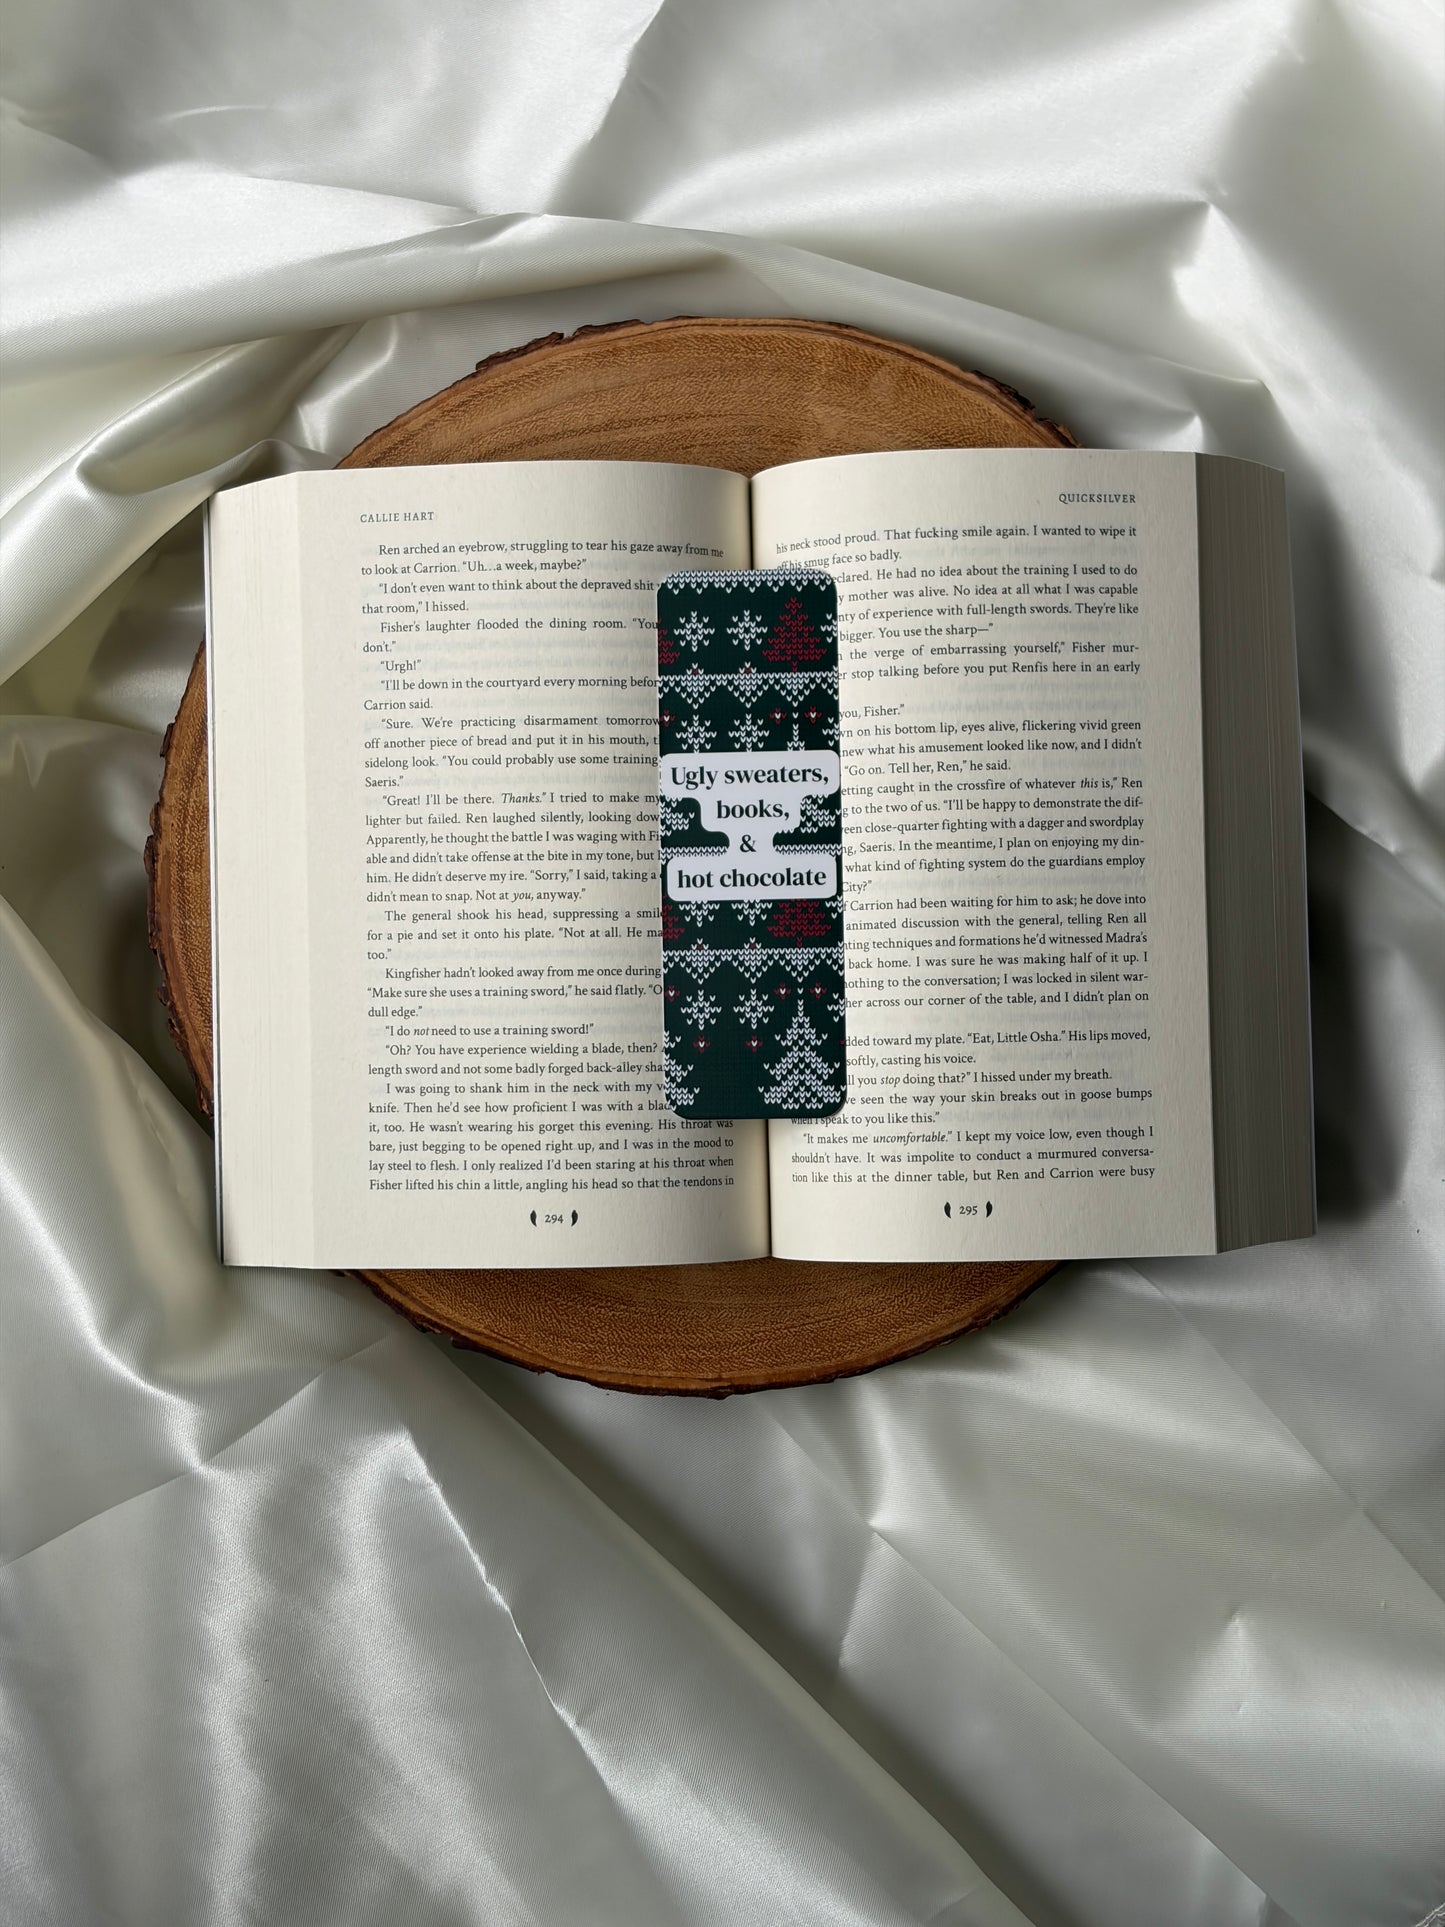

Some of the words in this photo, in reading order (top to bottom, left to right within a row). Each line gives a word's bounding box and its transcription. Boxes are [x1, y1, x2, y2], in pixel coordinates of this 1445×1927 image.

[1058, 493, 1136, 504] QUICKSILVER
[359, 512, 399, 523] CALLIE
[403, 511, 435, 521] HART
[776, 543, 788, 554] his
[790, 538, 810, 551] neck
[813, 533, 841, 547] stood
[844, 530, 880, 547] proud.
[883, 529, 911, 540] That
[914, 526, 959, 540] fucking
[961, 525, 992, 537] smile
[995, 525, 1029, 539] again.
[1033, 524, 1037, 536] I
[1040, 524, 1081, 536] wanted
[1084, 527, 1096, 536] to
[1098, 525, 1126, 539] wipe
[1128, 526, 1136, 537] it
[379, 544, 400, 555] Ren
[403, 542, 439, 554] arched
[442, 545, 455, 553] an
[458, 541, 507, 555] eyebrow,
[510, 539, 569, 554] struggling
[571, 541, 583, 550] to
[585, 541, 608, 551] tear
[610, 539, 627, 551] his
[629, 543, 654, 554] gaze
[656, 544, 683, 557] away
[684, 542, 709, 556] from
[710, 548, 724, 558] me
[361, 567, 372, 575] to
[374, 563, 398, 575] look
[400, 565, 411, 574] at
[413, 562, 460, 573] Carrion.
[504, 559, 537, 572] week,
[539, 558, 587, 573] maybe?”
[361, 603, 383, 614] that
[386, 601, 422, 614] room,”
[425, 601, 429, 612] I
[432, 600, 468, 612] hissed.
[839, 630, 875, 643] bigger.
[878, 627, 900, 638] You
[902, 628, 922, 637] use
[924, 624, 943, 636] the
[362, 640, 396, 652] don’t.”
[380, 659, 421, 674] “Urgh!”
[363, 699, 406, 710] Carrion
[408, 697, 433, 709] said.
[844, 765, 865, 776] “Go
[867, 766, 885, 775] on.
[887, 761, 909, 774] Tell
[912, 761, 934, 774] her,
[936, 759, 967, 773] Ren,”
[969, 759, 983, 771] he
[985, 758, 1011, 771] said.
[364, 775, 404, 787] Saeris.”
[671, 766, 718, 790] Ugly
[724, 766, 828, 784] sweaters,
[716, 799, 789, 820] books,
[739, 834, 756, 853] &
[677, 869, 713, 888] hot
[719, 867, 826, 887] chocolate
[366, 890, 396, 902] didn’t
[399, 893, 428, 902] mean
[431, 893, 442, 901] to
[444, 893, 472, 904] snap.
[475, 889, 496, 900] Not
[498, 892, 509, 900] at
[510, 892, 534, 903] you,
[536, 887, 586, 902] anyway.”
[367, 948, 392, 960] too.”
[848, 957, 873, 969] back
[876, 957, 911, 968] home.
[915, 955, 920, 967] I
[924, 958, 947, 967] was
[950, 957, 975, 966] sure
[978, 954, 993, 966] he
[996, 956, 1019, 965] was
[1022, 952, 1066, 967] making
[1069, 951, 1093, 964] half
[1095, 951, 1108, 963] of
[1110, 952, 1119, 963] it
[1122, 954, 1139, 966] up.
[1143, 950, 1148, 962] I
[367, 1006, 388, 1017] dull
[391, 1005, 423, 1020] edge.”
[385, 1025, 394, 1036] “I
[396, 1025, 411, 1036] do
[413, 1027, 429, 1036] not
[431, 1024, 457, 1036] need
[459, 1027, 471, 1036] to
[473, 1027, 491, 1036] use
[493, 1027, 500, 1035] a
[502, 1024, 548, 1038] training
[550, 1022, 594, 1035] sword!”
[846, 1055, 878, 1069] softly,
[880, 1054, 922, 1068] casting
[923, 1052, 941, 1064] his
[943, 1052, 976, 1063] voice.
[856, 1077, 877, 1088] you
[880, 1075, 900, 1088] stop
[902, 1073, 935, 1087] doing
[937, 1071, 971, 1084] that?”
[973, 1071, 978, 1083] I
[980, 1070, 1016, 1082] hissed
[1018, 1069, 1052, 1082] under
[1053, 1072, 1072, 1084] my
[1073, 1068, 1112, 1080] breath.
[803, 1133, 814, 1144] “It
[817, 1133, 848, 1144] makes
[852, 1135, 868, 1144] me
[873, 1130, 953, 1146] uncomfortable.”
[956, 1130, 961, 1142] I
[965, 1130, 991, 1145] kept
[994, 1132, 1012, 1144] my
[1015, 1129, 1045, 1140] voice
[1048, 1128, 1072, 1141] low,
[1075, 1130, 1102, 1139] even
[1105, 1125, 1145, 1140] though
[1148, 1125, 1153, 1137] I
[791, 1173, 808, 1182] tion
[811, 1171, 829, 1183] like
[832, 1171, 852, 1182] this
[856, 1174, 866, 1182] at
[871, 1171, 889, 1182] the
[894, 1170, 932, 1182] dinner
[936, 1169, 968, 1183] table,
[972, 1169, 991, 1181] but
[996, 1168, 1019, 1180] Ren
[1023, 1167, 1045, 1179] and
[1049, 1167, 1094, 1179] Carrion
[1098, 1168, 1125, 1177] were
[1129, 1165, 1155, 1179] busy
[369, 1179, 403, 1190] Fisher
[405, 1178, 434, 1190] lifted
[437, 1178, 453, 1190] his
[456, 1178, 481, 1190] chin
[484, 1182, 490, 1190] a
[493, 1178, 522, 1192] little,
[525, 1178, 568, 1193] angling
[571, 1178, 588, 1190] his
[591, 1177, 618, 1189] head
[621, 1180, 634, 1189] so
[637, 1177, 660, 1188] that
[662, 1176, 681, 1188] the
[682, 1175, 723, 1188] tendons
[724, 1175, 734, 1186] in
[544, 1214, 564, 1224] 294
[959, 1205, 978, 1216] 295
